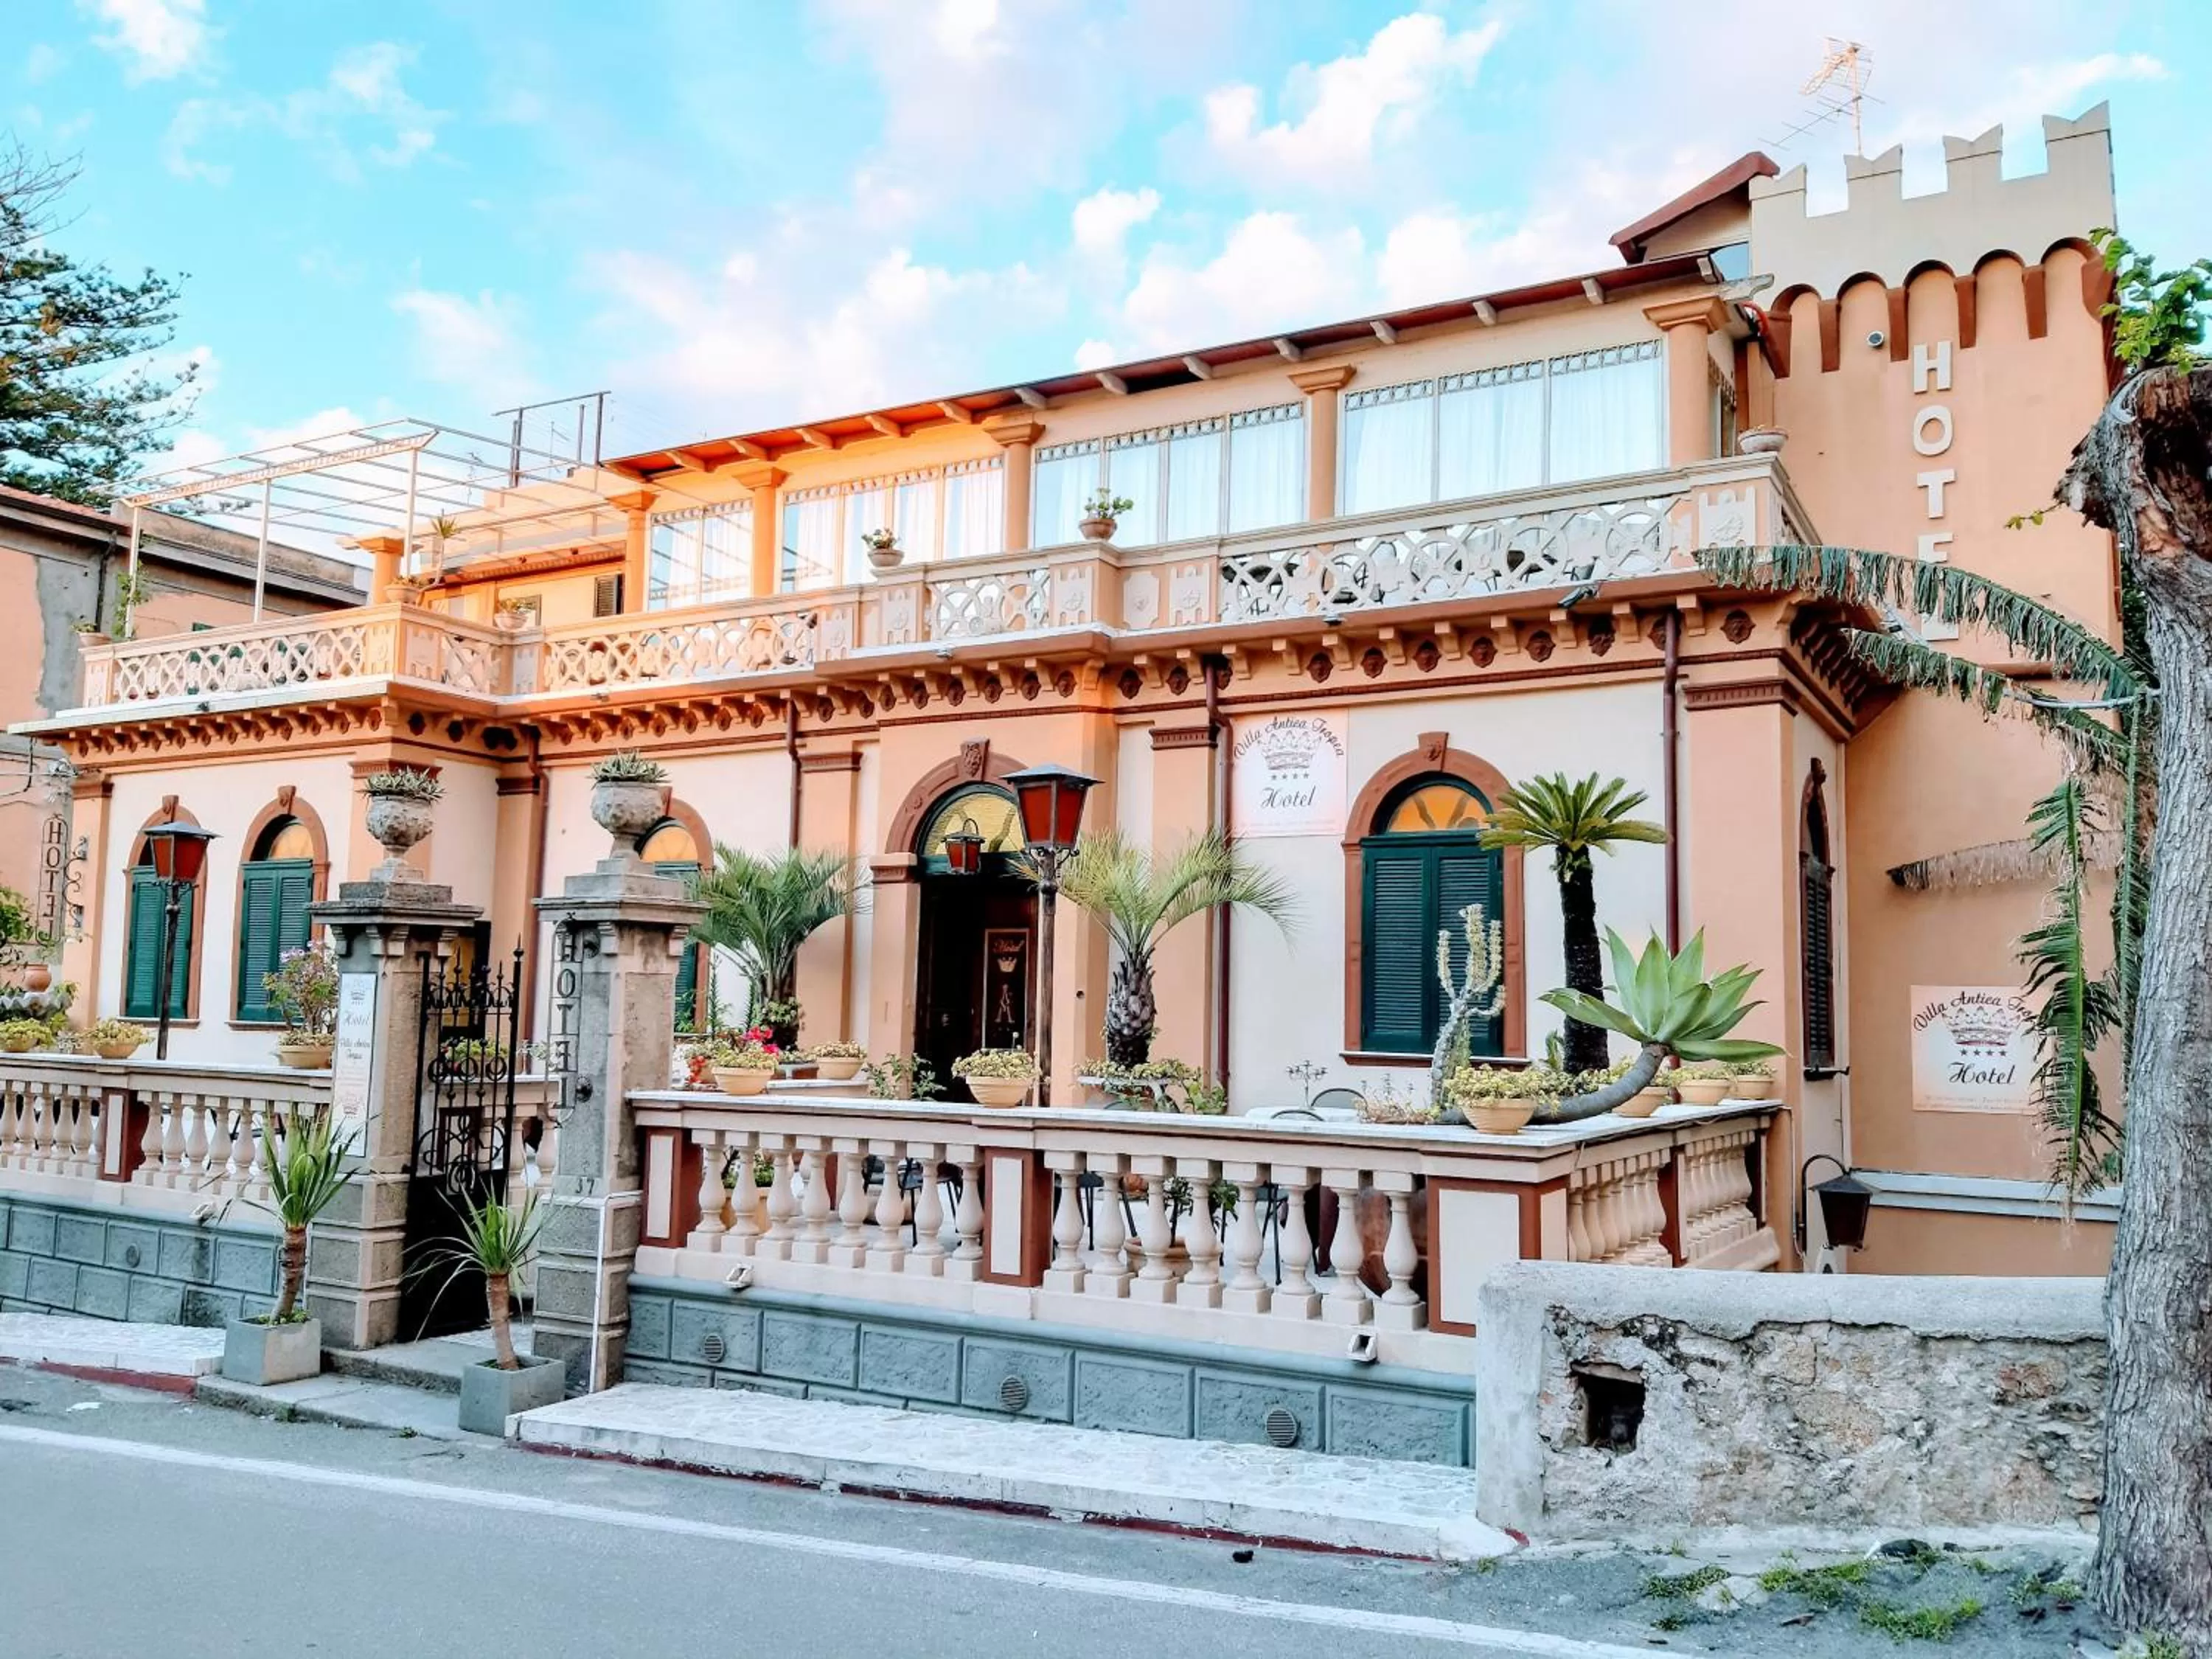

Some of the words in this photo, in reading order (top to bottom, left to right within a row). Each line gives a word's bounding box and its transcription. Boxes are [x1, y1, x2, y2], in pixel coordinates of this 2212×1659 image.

[1234, 728, 1262, 759] Villa
[1265, 715, 1310, 734] Antica
[1312, 717, 1345, 757] Tropea
[1261, 785, 1316, 810] Hotel
[1913, 1002, 1948, 1032] Villa
[1950, 990, 2003, 1008] Antica
[1948, 1060, 2017, 1085] Hotel
